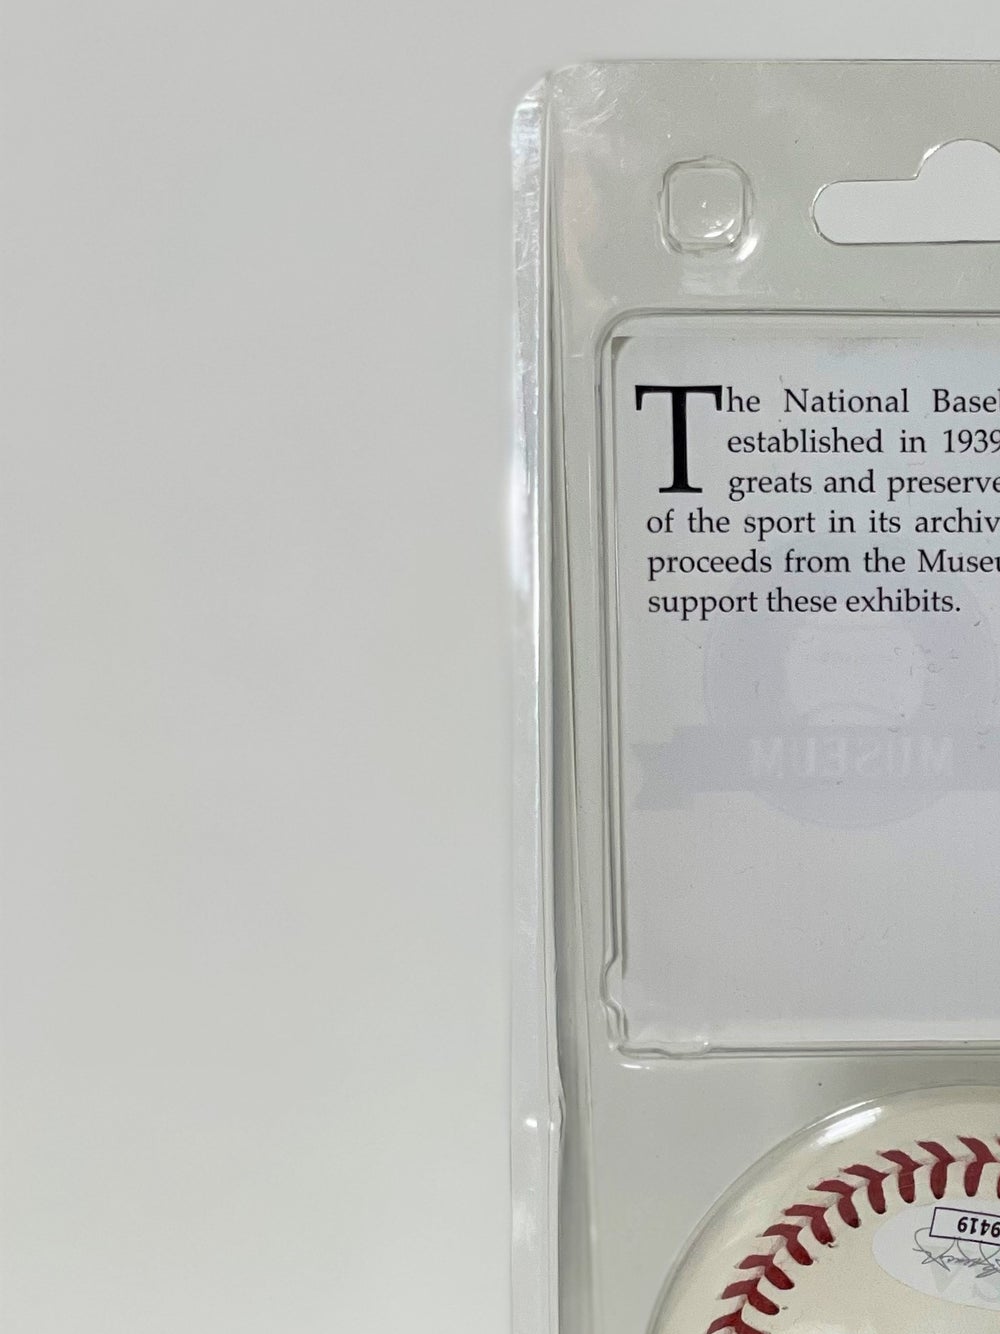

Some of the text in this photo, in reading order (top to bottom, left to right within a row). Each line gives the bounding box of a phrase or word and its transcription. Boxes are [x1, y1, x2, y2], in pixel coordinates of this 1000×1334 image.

[783, 387, 910, 413] National
[727, 426, 884, 454] established
[899, 429, 927, 453] in
[728, 472, 813, 501] greats
[823, 468, 876, 494] and
[646, 507, 675, 534] of
[687, 506, 731, 534] the
[744, 511, 816, 541] sport
[829, 509, 856, 534] in
[869, 509, 901, 534] its
[647, 547, 773, 582] proceeds
[784, 547, 850, 574] from
[863, 546, 906, 574] the
[648, 586, 961, 621] support these exhibits.
